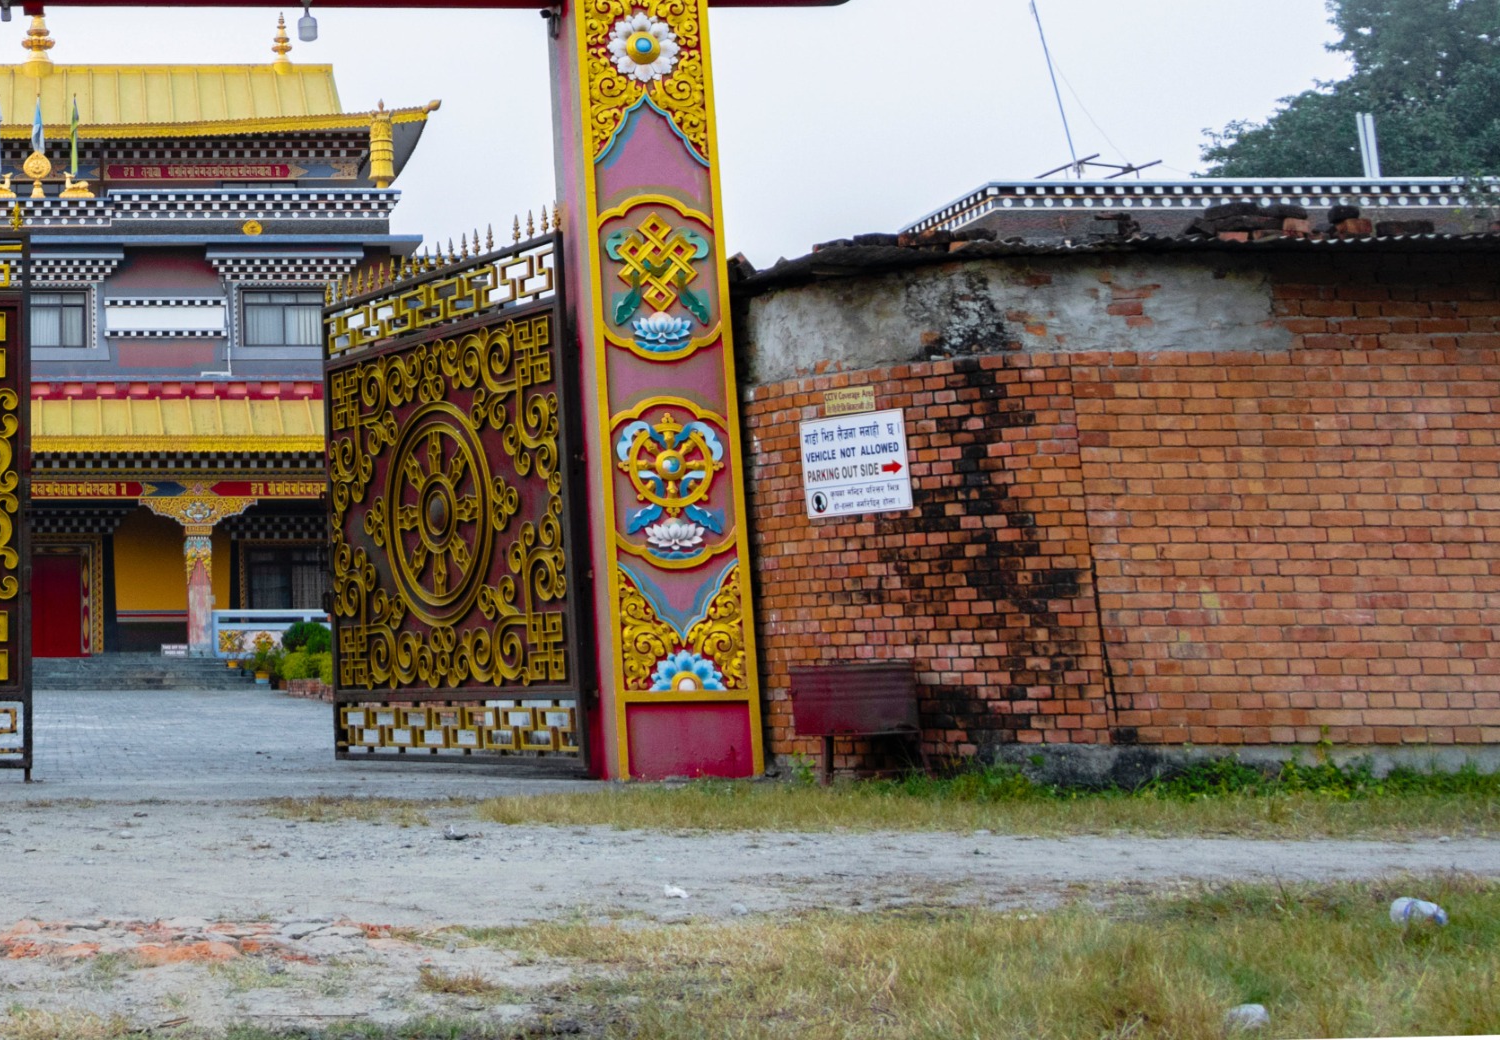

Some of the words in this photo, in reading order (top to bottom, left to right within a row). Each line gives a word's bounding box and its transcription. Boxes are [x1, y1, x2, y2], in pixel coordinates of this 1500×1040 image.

[824, 393, 837, 401] CCTV
[838, 391, 860, 400] Coverage
[862, 389, 874, 398] Area
[805, 449, 836, 463] VEHICLE
[840, 447, 856, 458] NOT
[861, 441, 899, 456] ALLOWED
[807, 468, 840, 483] PARKING
[841, 465, 858, 479] OUT
[860, 463, 879, 477] SIDE
